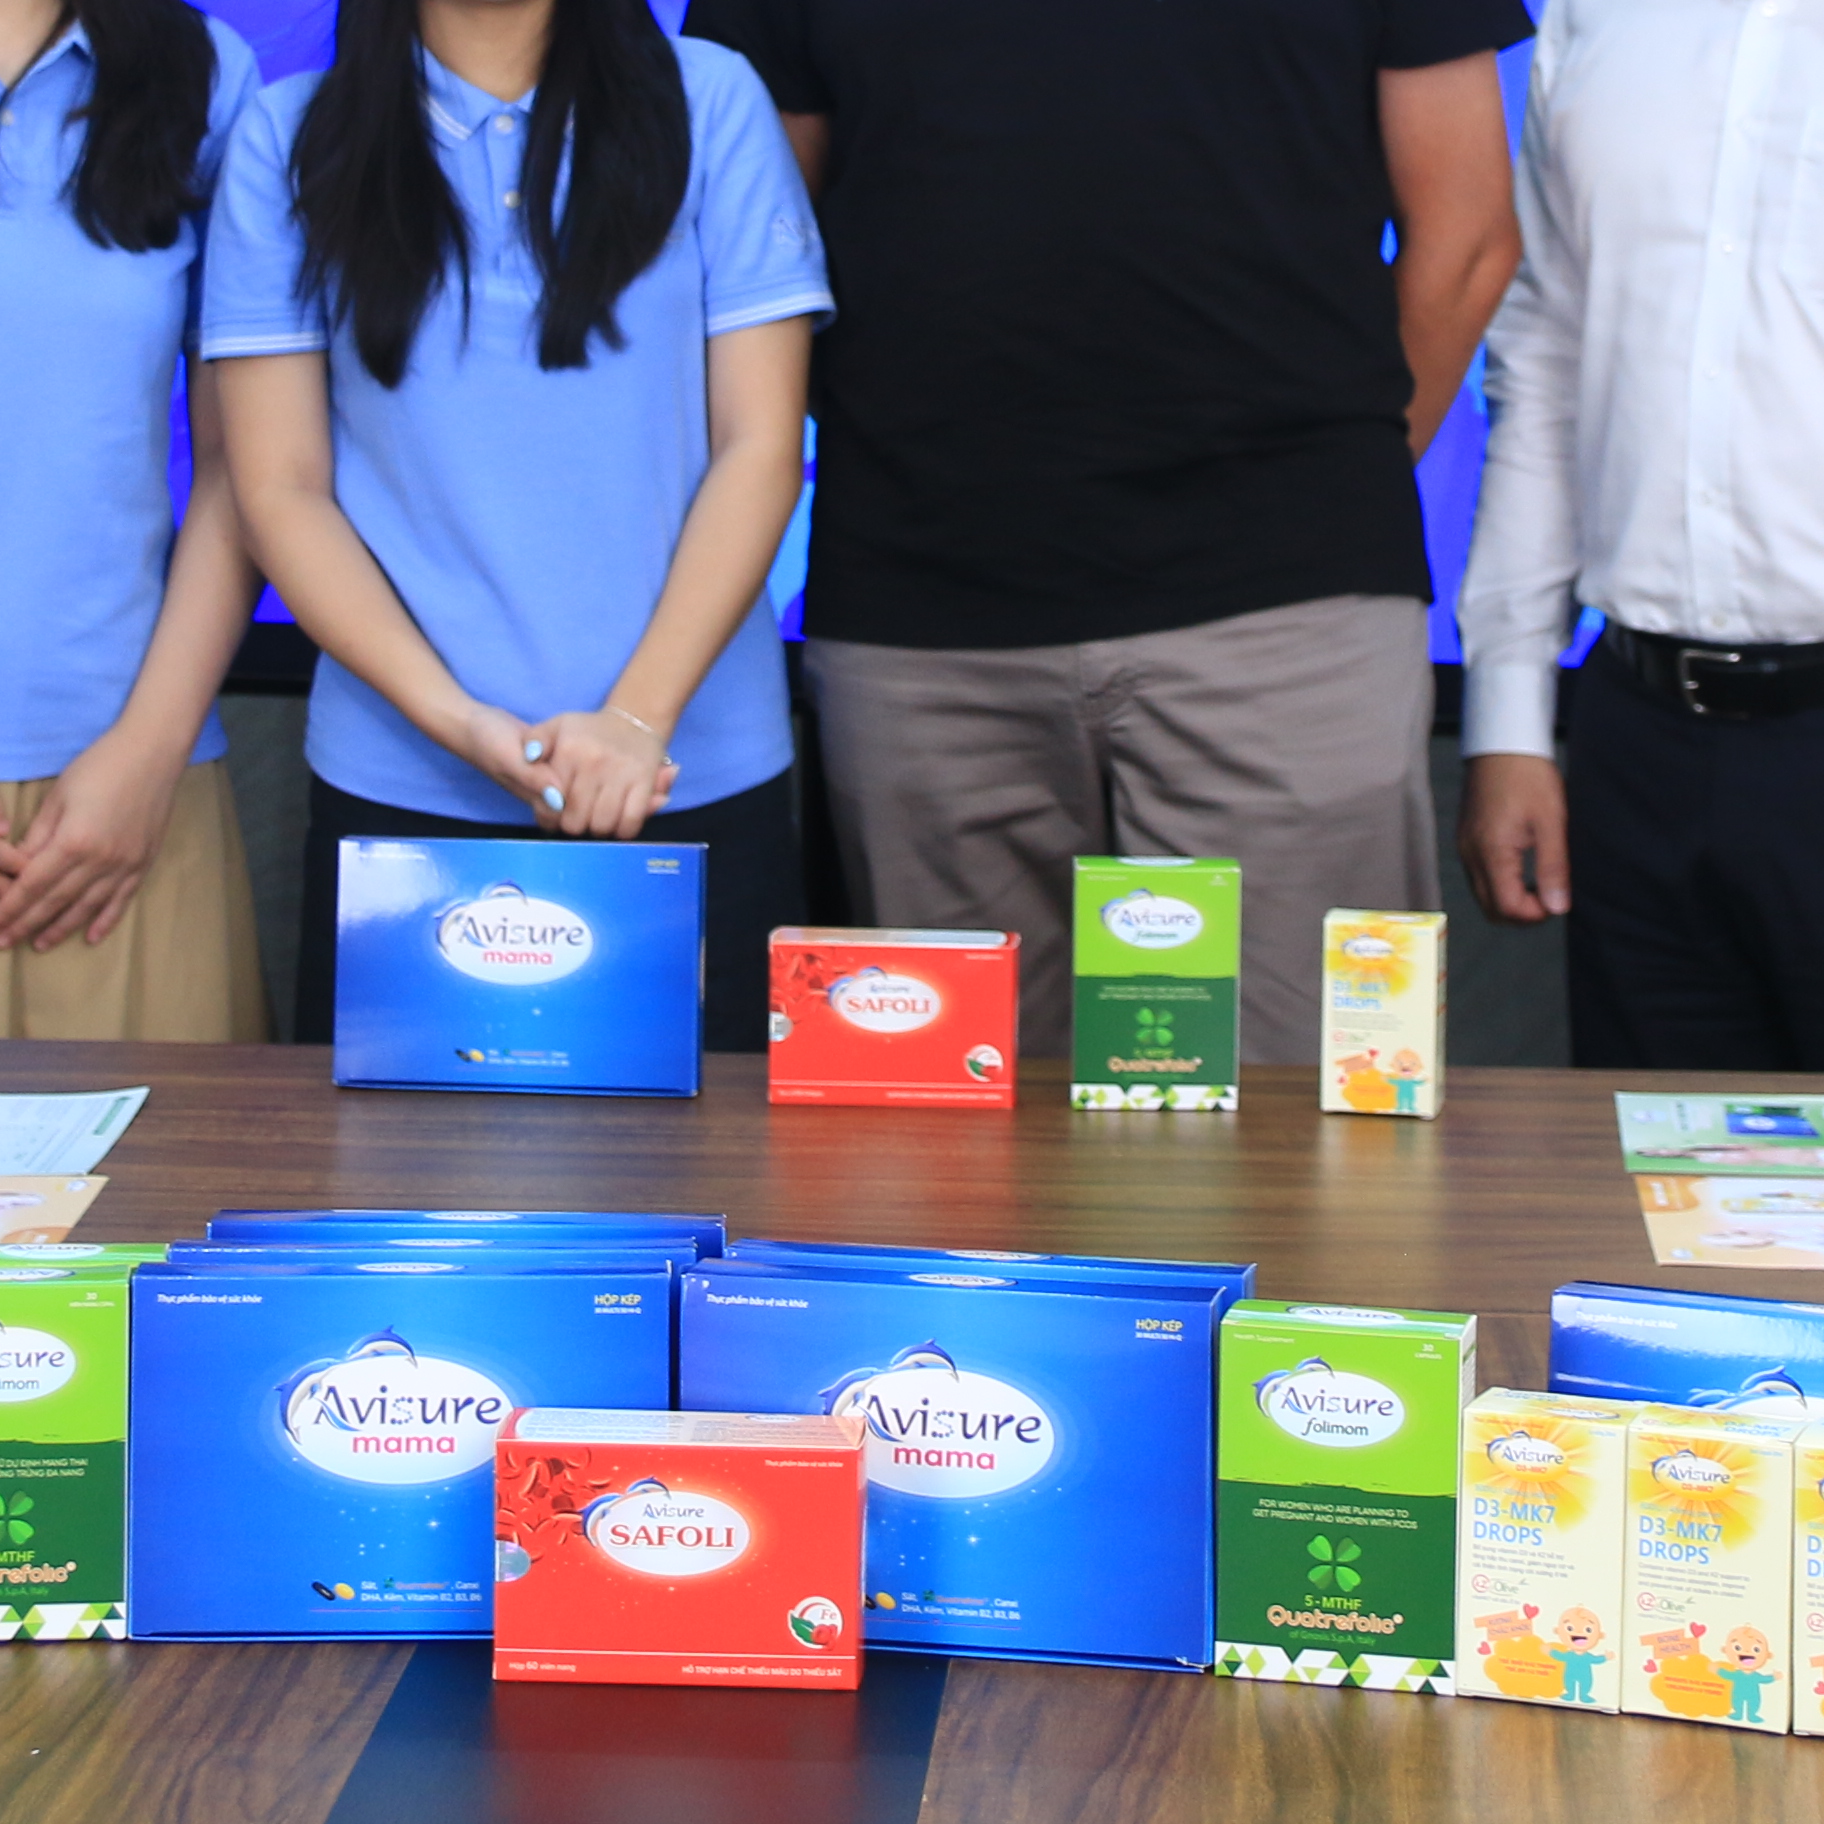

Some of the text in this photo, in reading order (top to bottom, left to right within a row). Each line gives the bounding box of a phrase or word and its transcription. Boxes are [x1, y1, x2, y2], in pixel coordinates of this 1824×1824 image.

[459, 916, 584, 947] Avisure
[483, 950, 553, 966] mama
[846, 997, 931, 1014] SAFOLI
[1333, 996, 1382, 1010] DROPS
[594, 1293, 642, 1306] HỘP KÉP
[1311, 1307, 1397, 1319] Avisure
[1135, 1318, 1183, 1332] HỘP KÉP
[313, 1385, 502, 1431] Avisure
[1281, 1387, 1394, 1416] Avisure
[867, 1394, 1042, 1443] Avisure
[1301, 1417, 1369, 1436] folimom
[352, 1436, 456, 1454] mama
[42, 1458, 68, 1467] MANG
[69, 1458, 88, 1466] THAI
[893, 1446, 995, 1469] mama
[1502, 1446, 1564, 1465] Avisure
[59, 1468, 84, 1477] NANG
[1668, 1463, 1731, 1484] Avisure
[643, 1503, 705, 1519] Avisure
[1259, 1498, 1409, 1518] FOR WOMEN WHO ARE PLANNING TO
[1474, 1497, 1556, 1524] D3-MK7
[1252, 1508, 1418, 1530] GET PREGNANT AND WOMEN WITH PCOS
[1639, 1515, 1723, 1542] D3-MK7
[609, 1523, 735, 1549] SAFOLI
[1473, 1521, 1543, 1546] DROPS
[1638, 1539, 1710, 1565] DROPS
[820, 1608, 838, 1620] Fe
[526, 1661, 539, 1670] 60
[790, 1667, 802, 1676] DO
